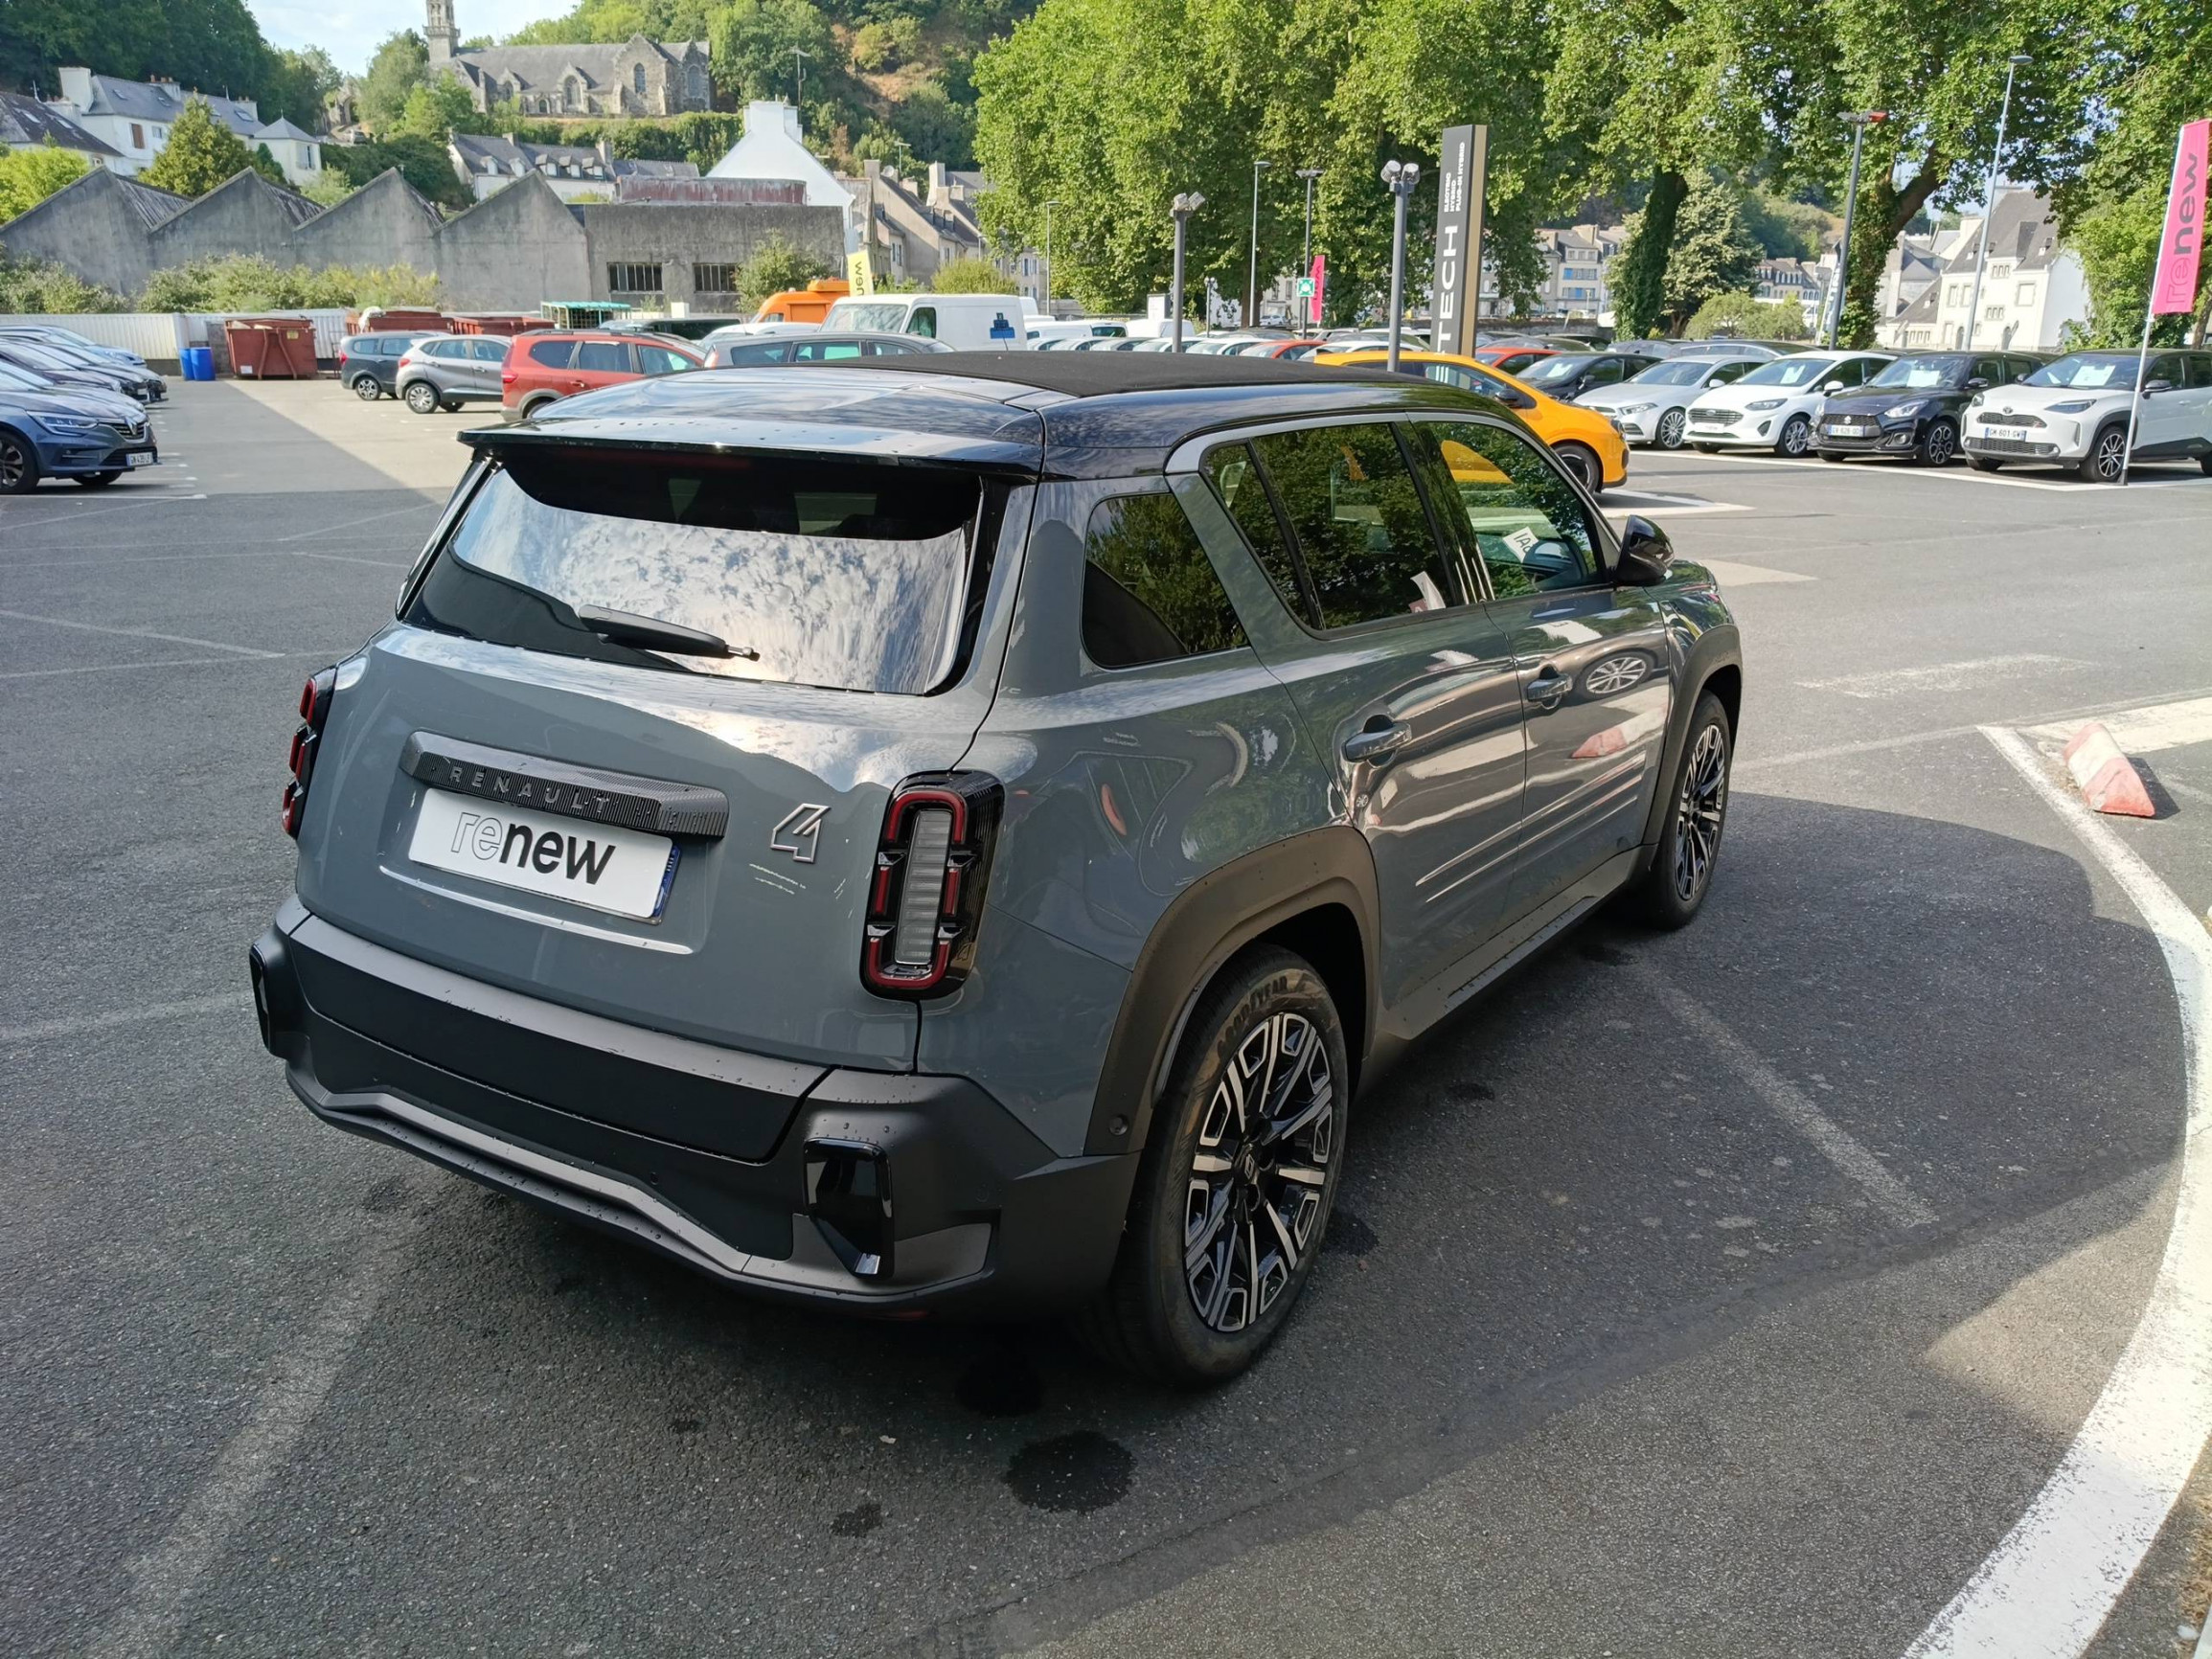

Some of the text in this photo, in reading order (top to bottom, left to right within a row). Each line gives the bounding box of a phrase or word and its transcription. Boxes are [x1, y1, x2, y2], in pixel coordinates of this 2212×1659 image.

[1457, 141, 1466, 175] HYBRID
[2166, 152, 2199, 305] renew
[448, 765, 610, 813] RENAULT
[450, 811, 617, 885] renew
